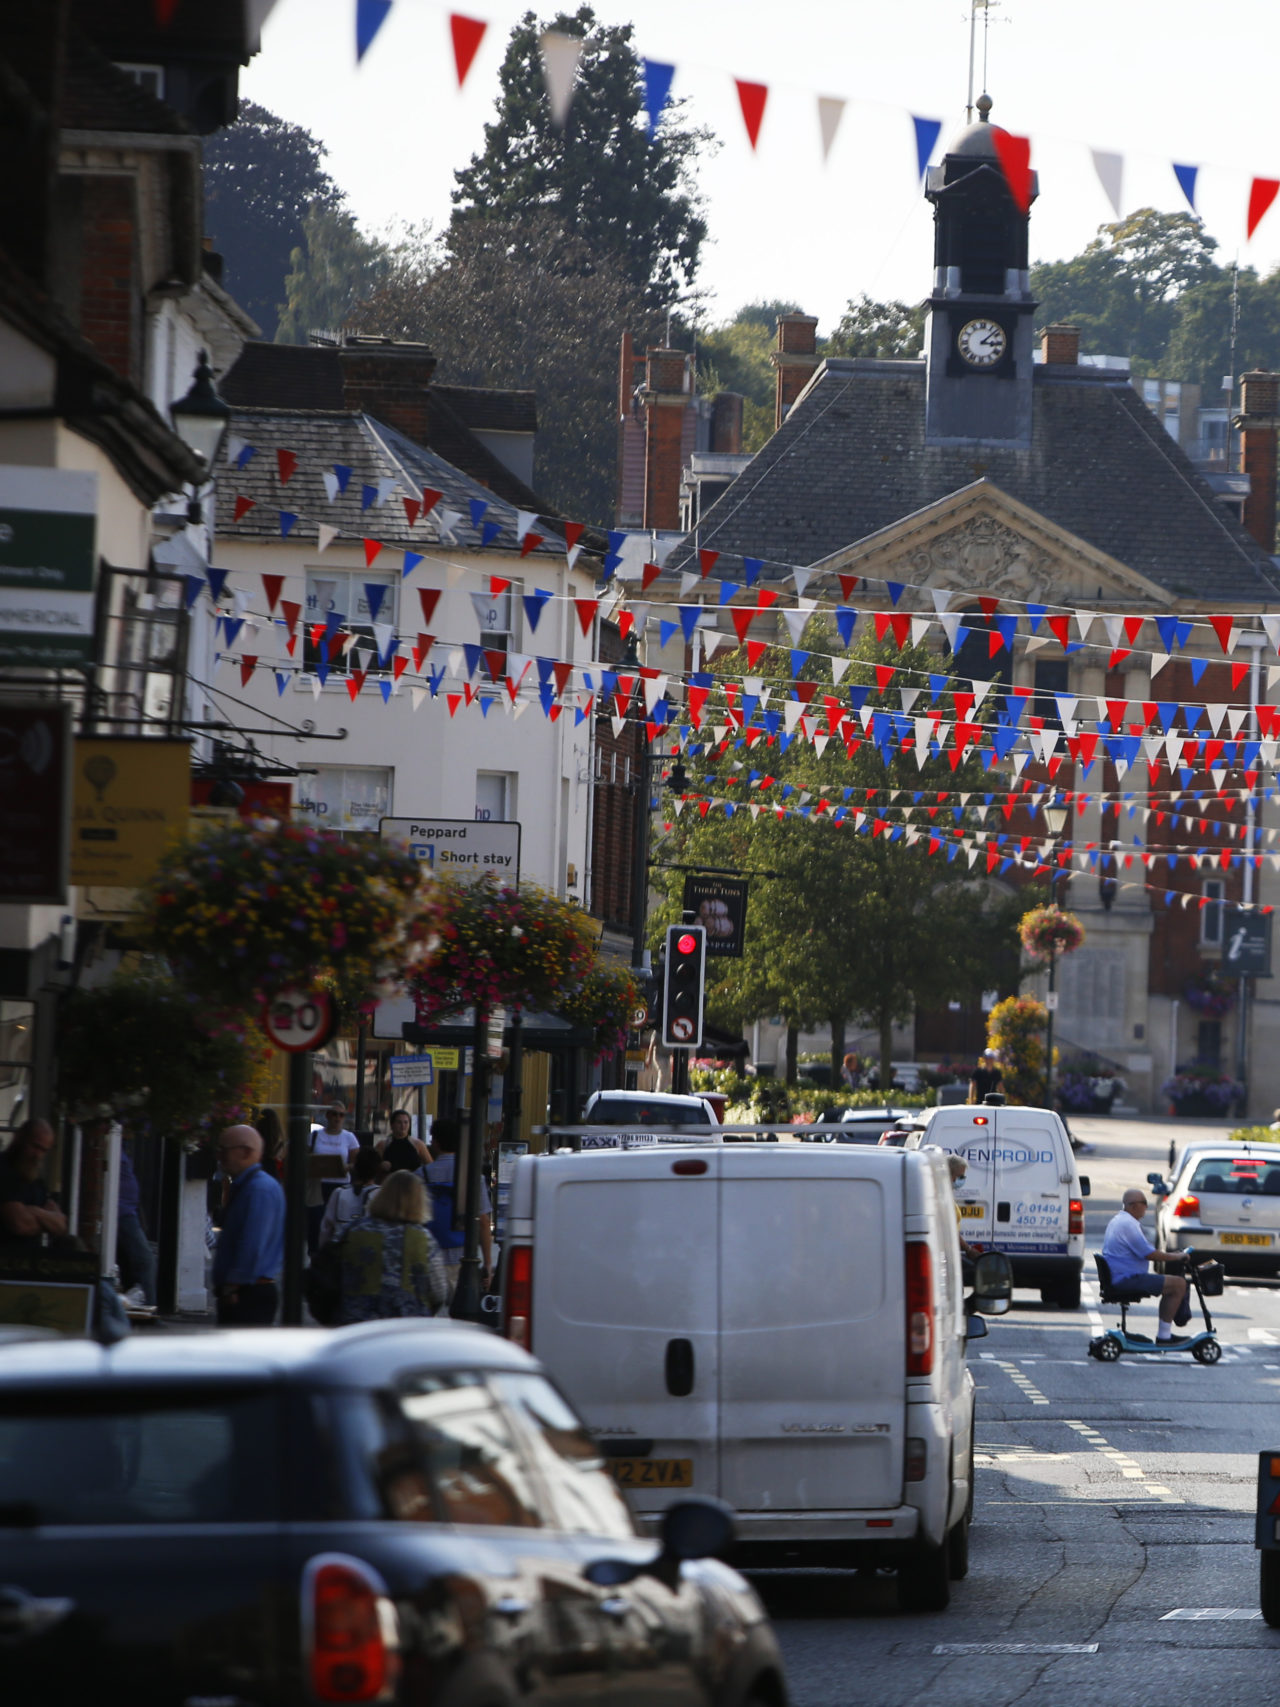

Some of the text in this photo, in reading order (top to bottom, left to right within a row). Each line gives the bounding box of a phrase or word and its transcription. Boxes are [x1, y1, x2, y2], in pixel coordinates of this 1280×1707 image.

[410, 825, 467, 839] Peppard
[440, 851, 512, 867] Short stay
[1029, 1203, 1062, 1213] 01494
[1017, 1216, 1059, 1225] 450 794
[641, 1462, 684, 1482] ZVA
